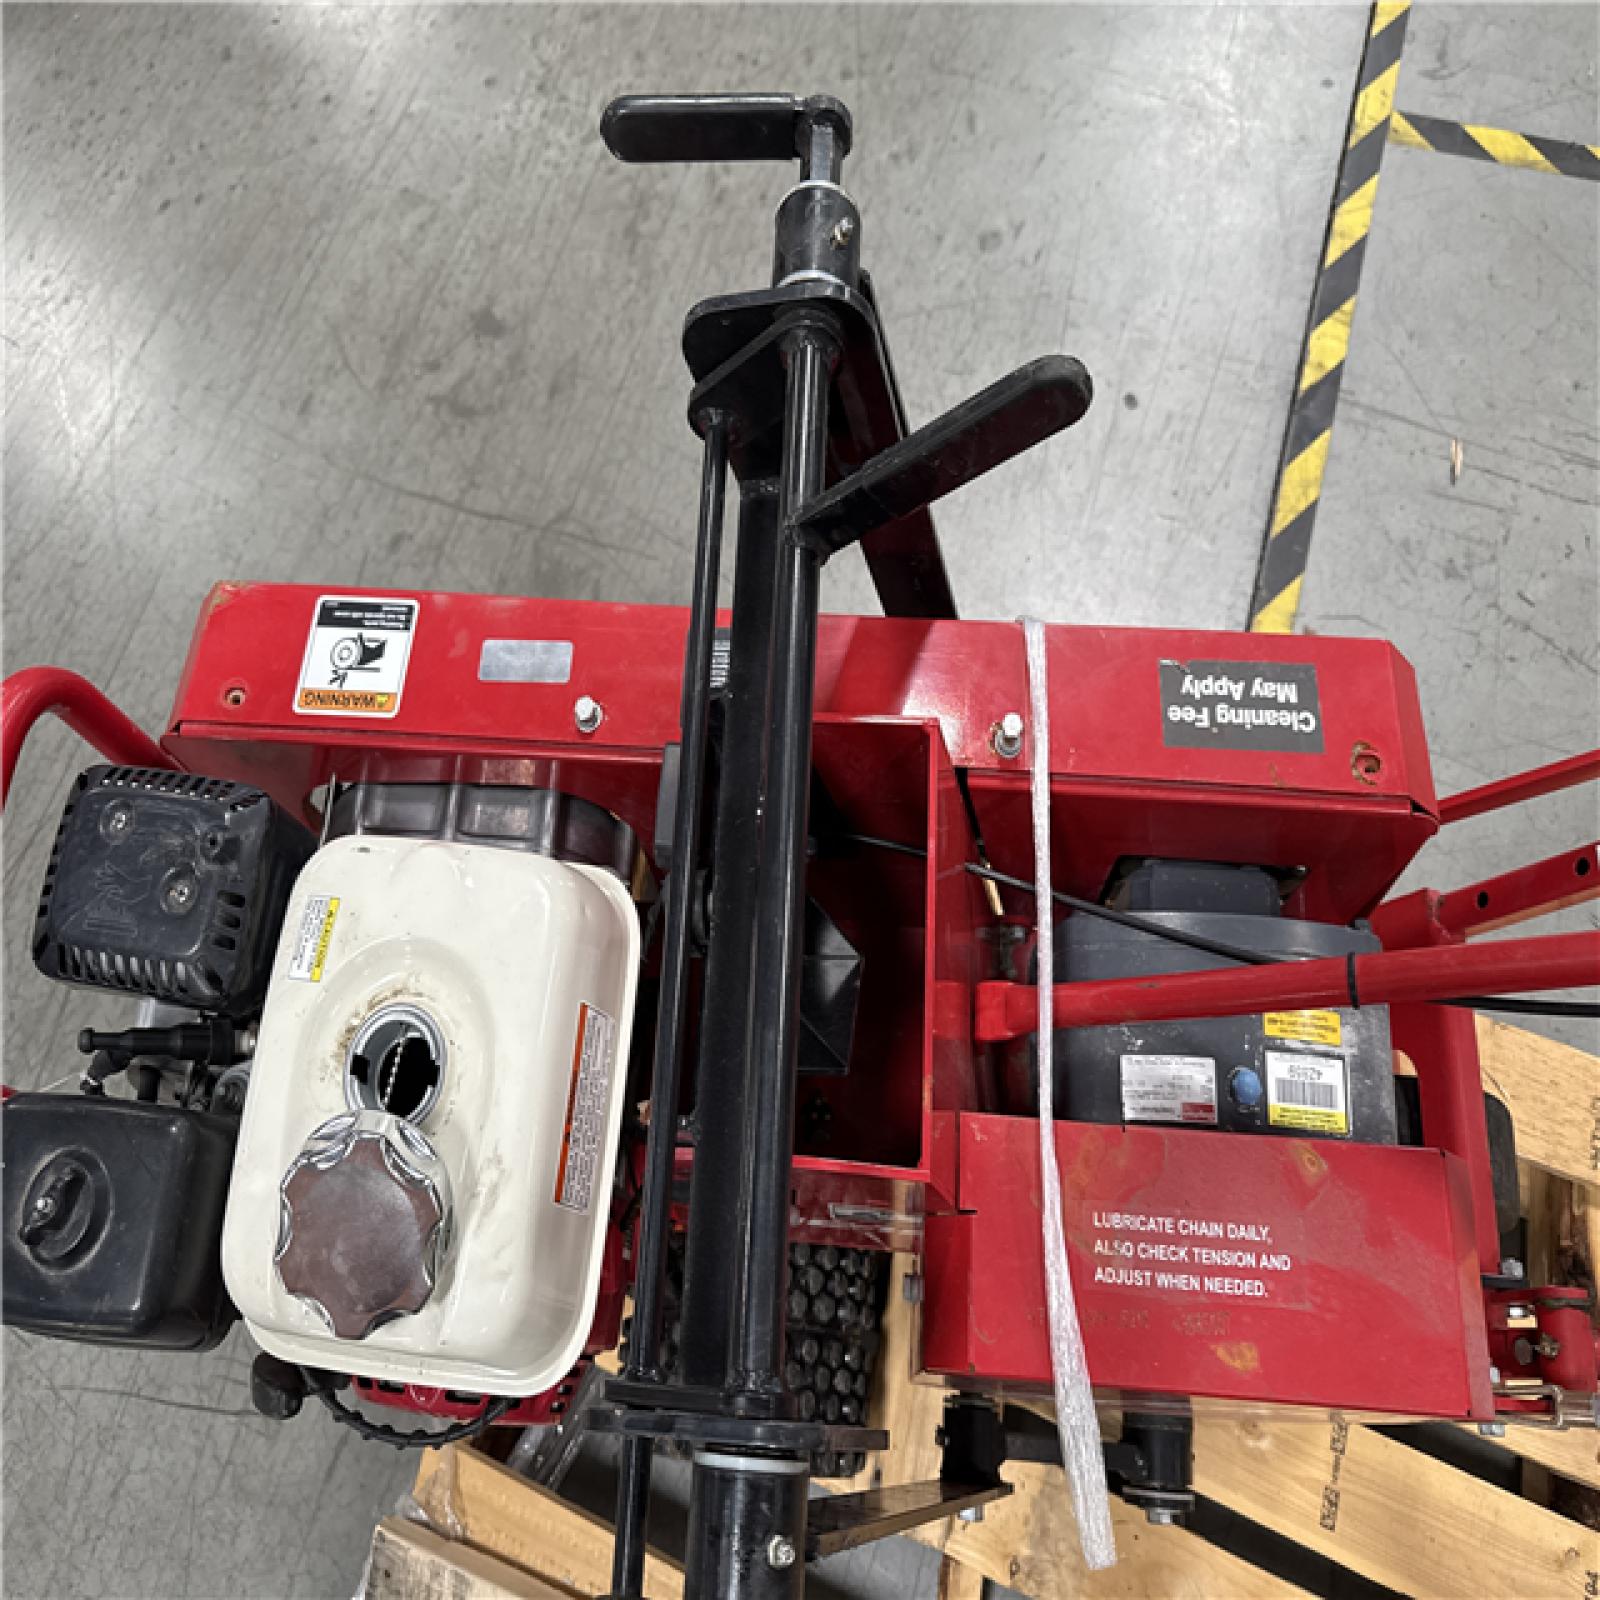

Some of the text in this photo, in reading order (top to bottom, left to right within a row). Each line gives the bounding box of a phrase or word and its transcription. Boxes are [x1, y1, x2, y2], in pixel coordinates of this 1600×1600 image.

[1181, 674, 1298, 703] May Apply
[1168, 702, 1316, 733] Cleaning Fee
[1092, 1211, 1273, 1246] LUBRICATE CHAIN DAILY,
[1093, 1239, 1291, 1272] ALSO CHECK TENSION AND
[1094, 1266, 1269, 1299] ADJUST WHEN NEEDED.
